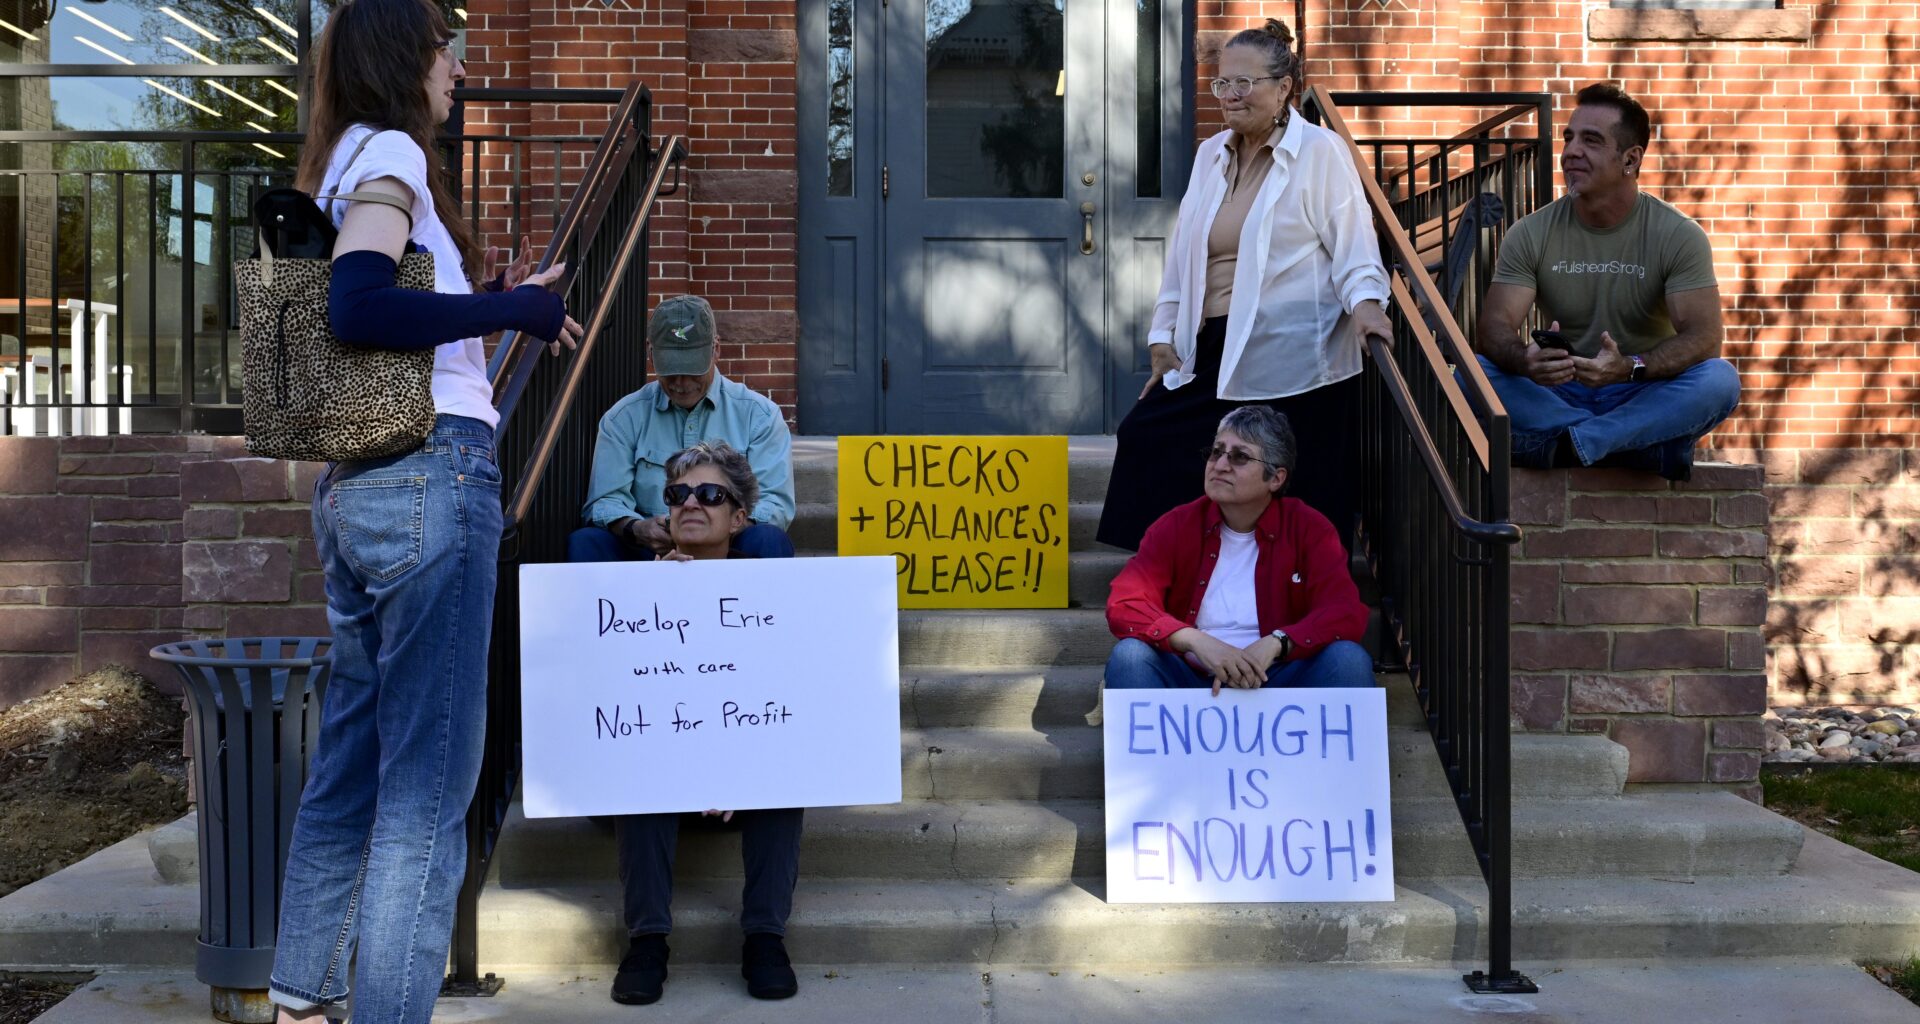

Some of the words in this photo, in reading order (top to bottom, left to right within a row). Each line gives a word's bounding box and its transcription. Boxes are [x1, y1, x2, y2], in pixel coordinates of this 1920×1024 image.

[1552, 260, 1645, 279] #FulshearStrong
[864, 441, 1029, 496] CHECKS
[885, 499, 1061, 547] BALANCES,
[598, 598, 690, 643] Develop
[719, 597, 775, 629] Erie
[633, 661, 684, 675] with
[698, 661, 737, 674] care
[595, 704, 651, 739] Not
[671, 702, 704, 734] for
[722, 702, 793, 728] Profit
[1128, 702, 1354, 761] ENOUGH
[1227, 768, 1269, 810] IS
[1132, 809, 1376, 884] ENOUGH!
